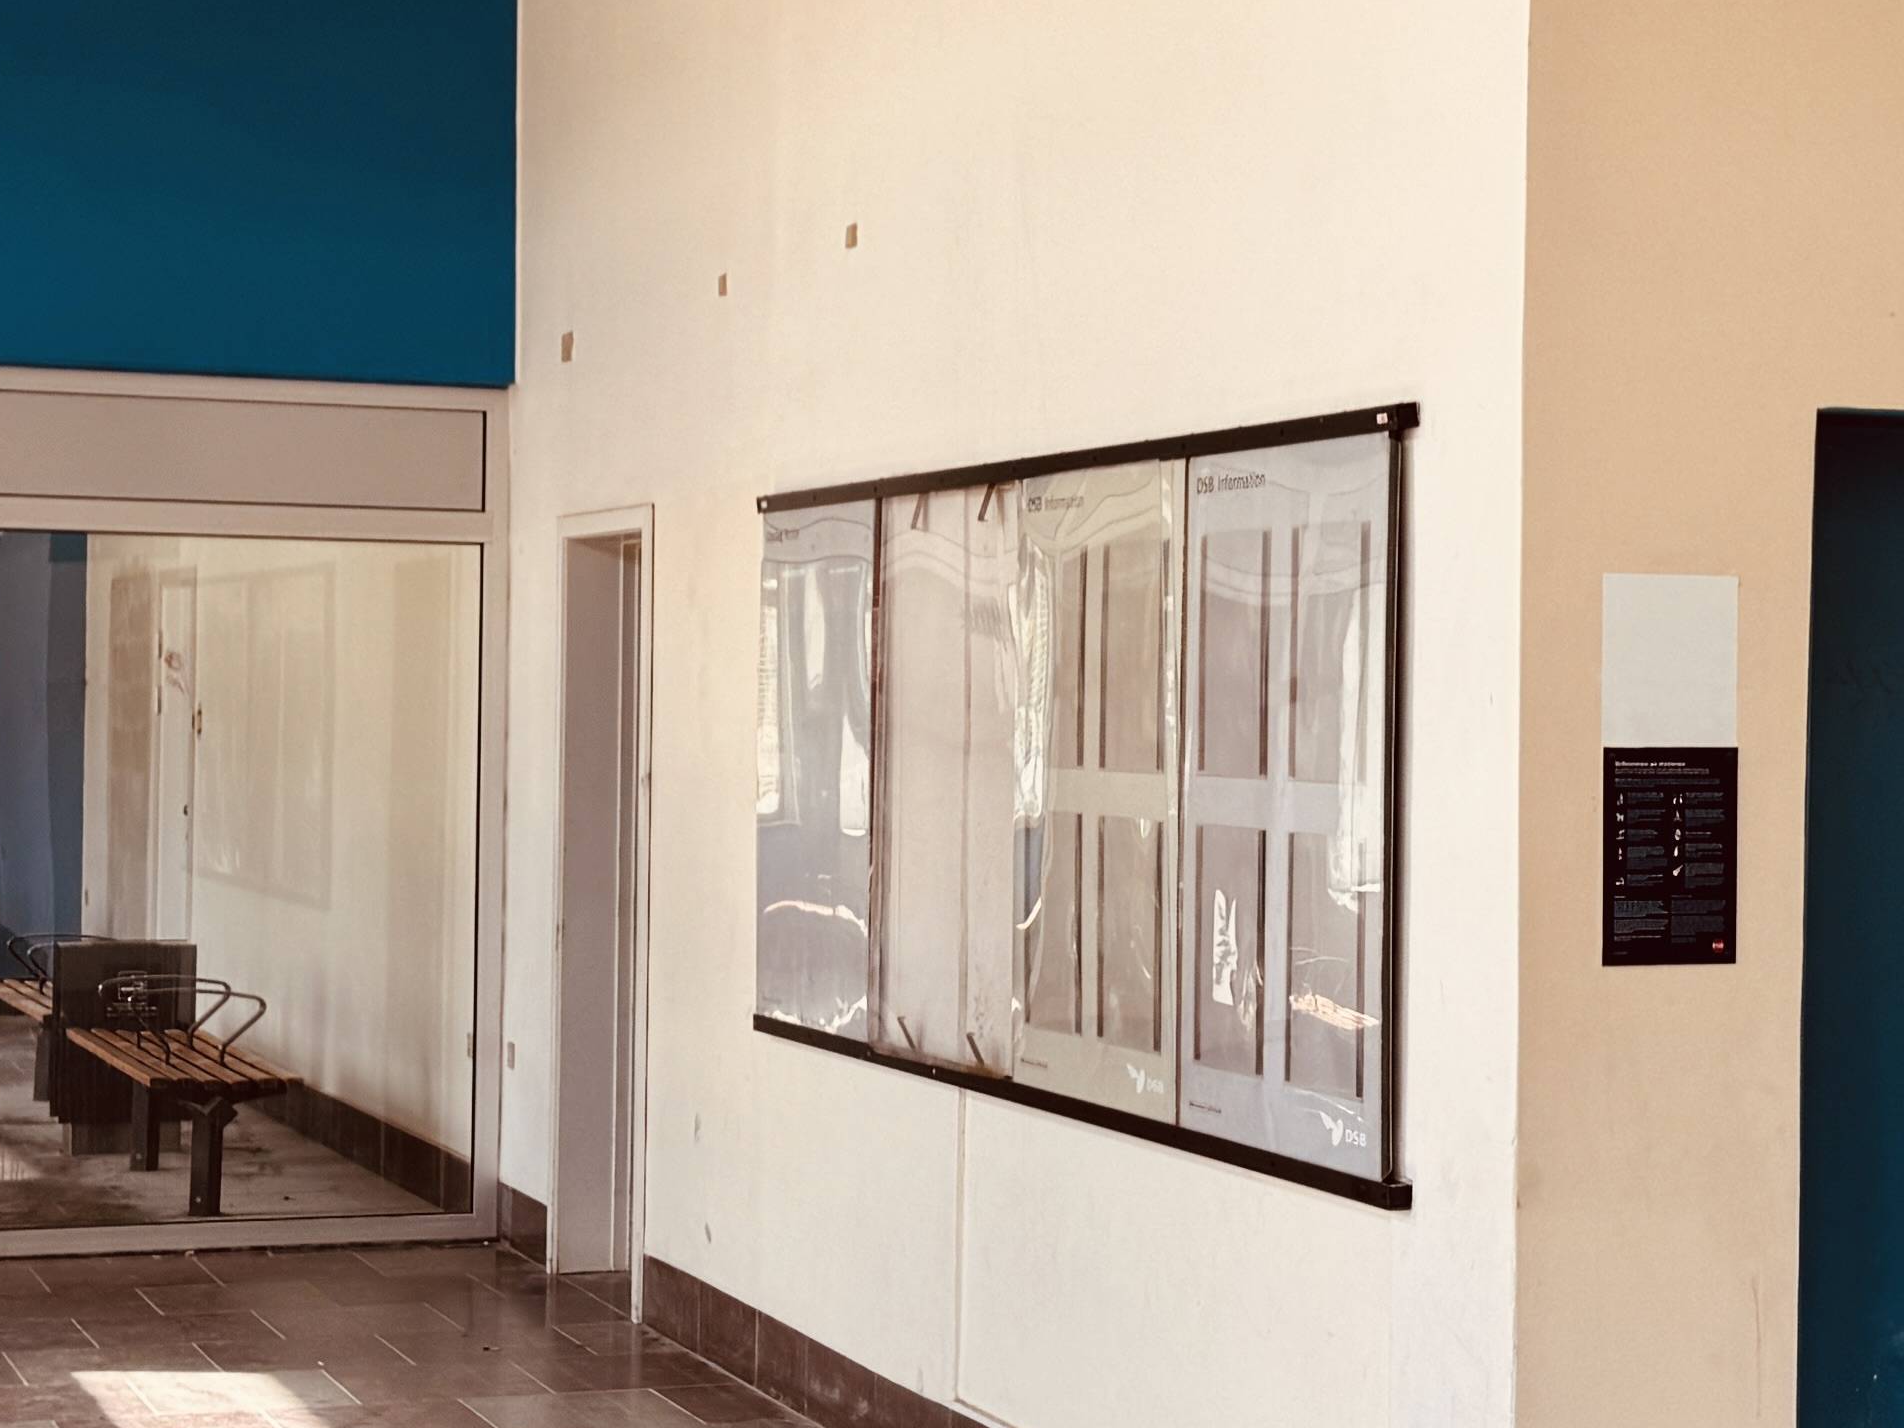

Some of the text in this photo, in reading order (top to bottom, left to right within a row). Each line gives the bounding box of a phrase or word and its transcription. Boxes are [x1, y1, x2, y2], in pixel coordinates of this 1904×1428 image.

[1196, 473, 1265, 494] DSB Information
[1345, 1129, 1367, 1147] DSB
